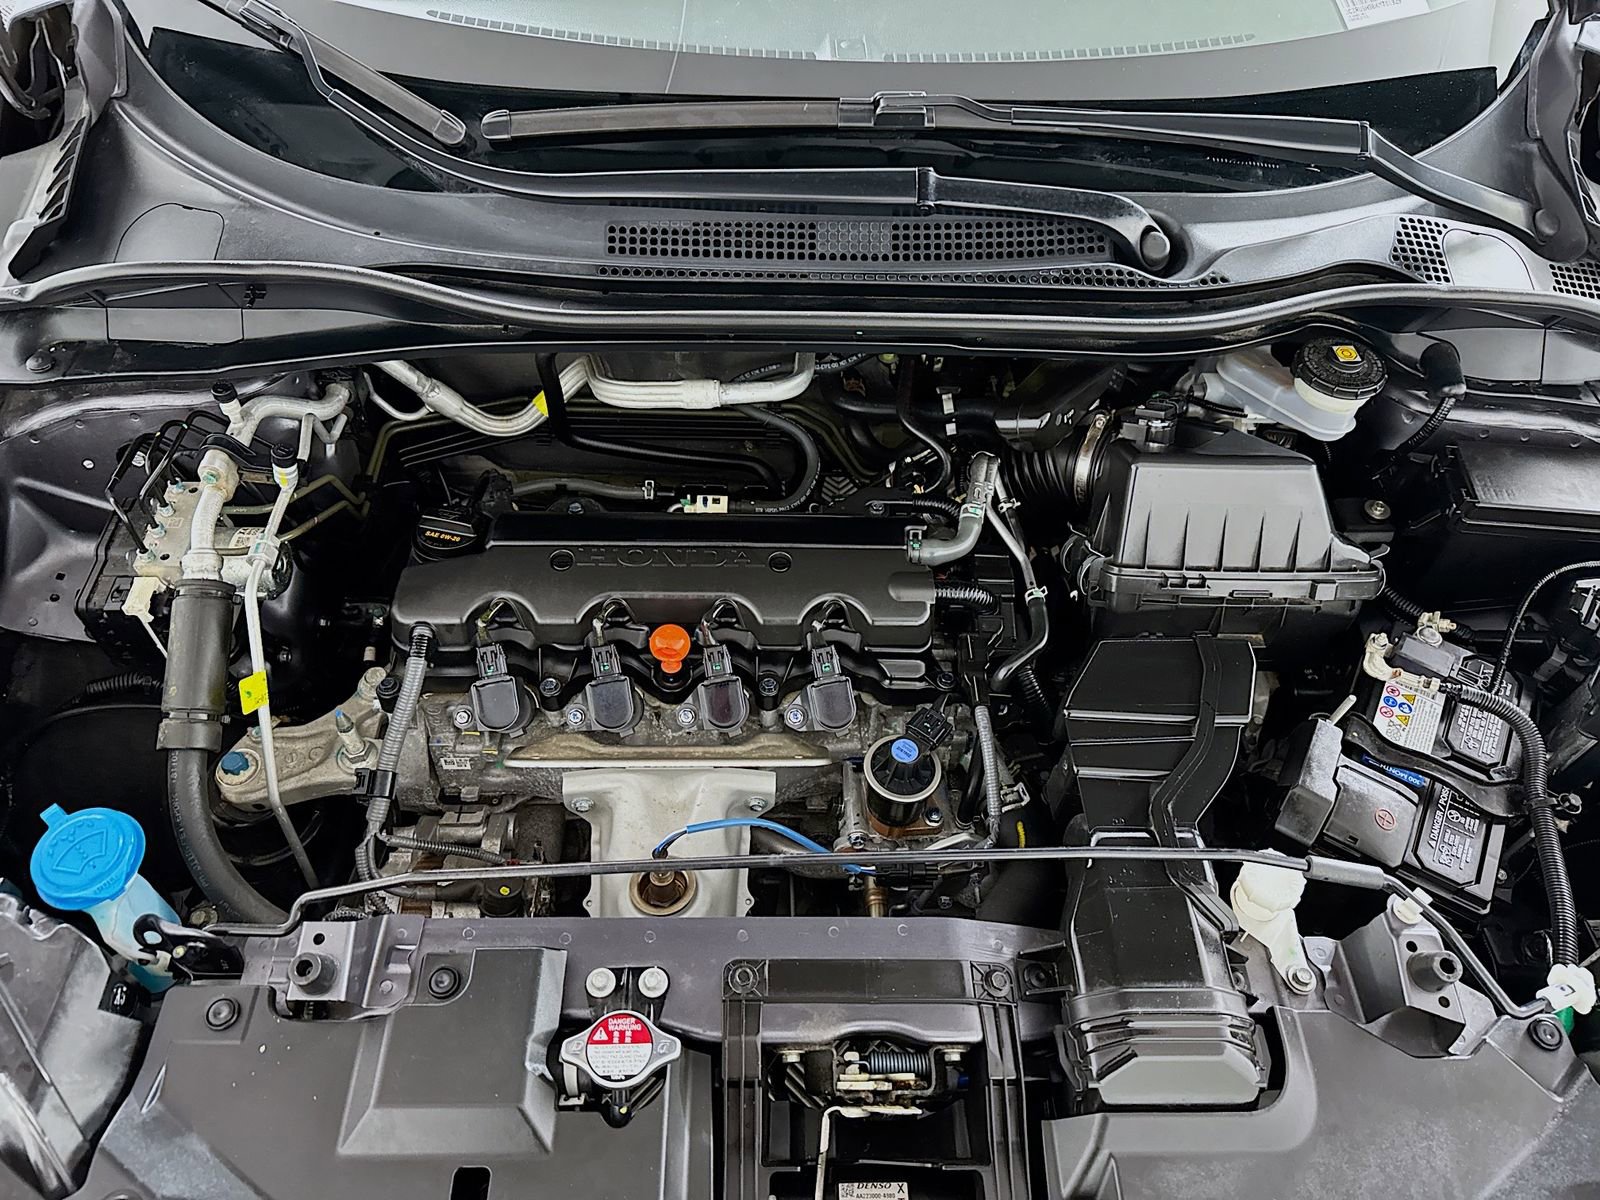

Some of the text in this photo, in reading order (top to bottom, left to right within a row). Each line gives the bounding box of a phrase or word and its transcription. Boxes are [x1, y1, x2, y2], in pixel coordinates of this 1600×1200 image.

[424, 530, 461, 542] SAE 0W-20
[576, 548, 766, 568] HONDA
[1429, 810, 1444, 844] DANGER
[608, 1017, 636, 1025] DANGER
[897, 1183, 905, 1194] X
